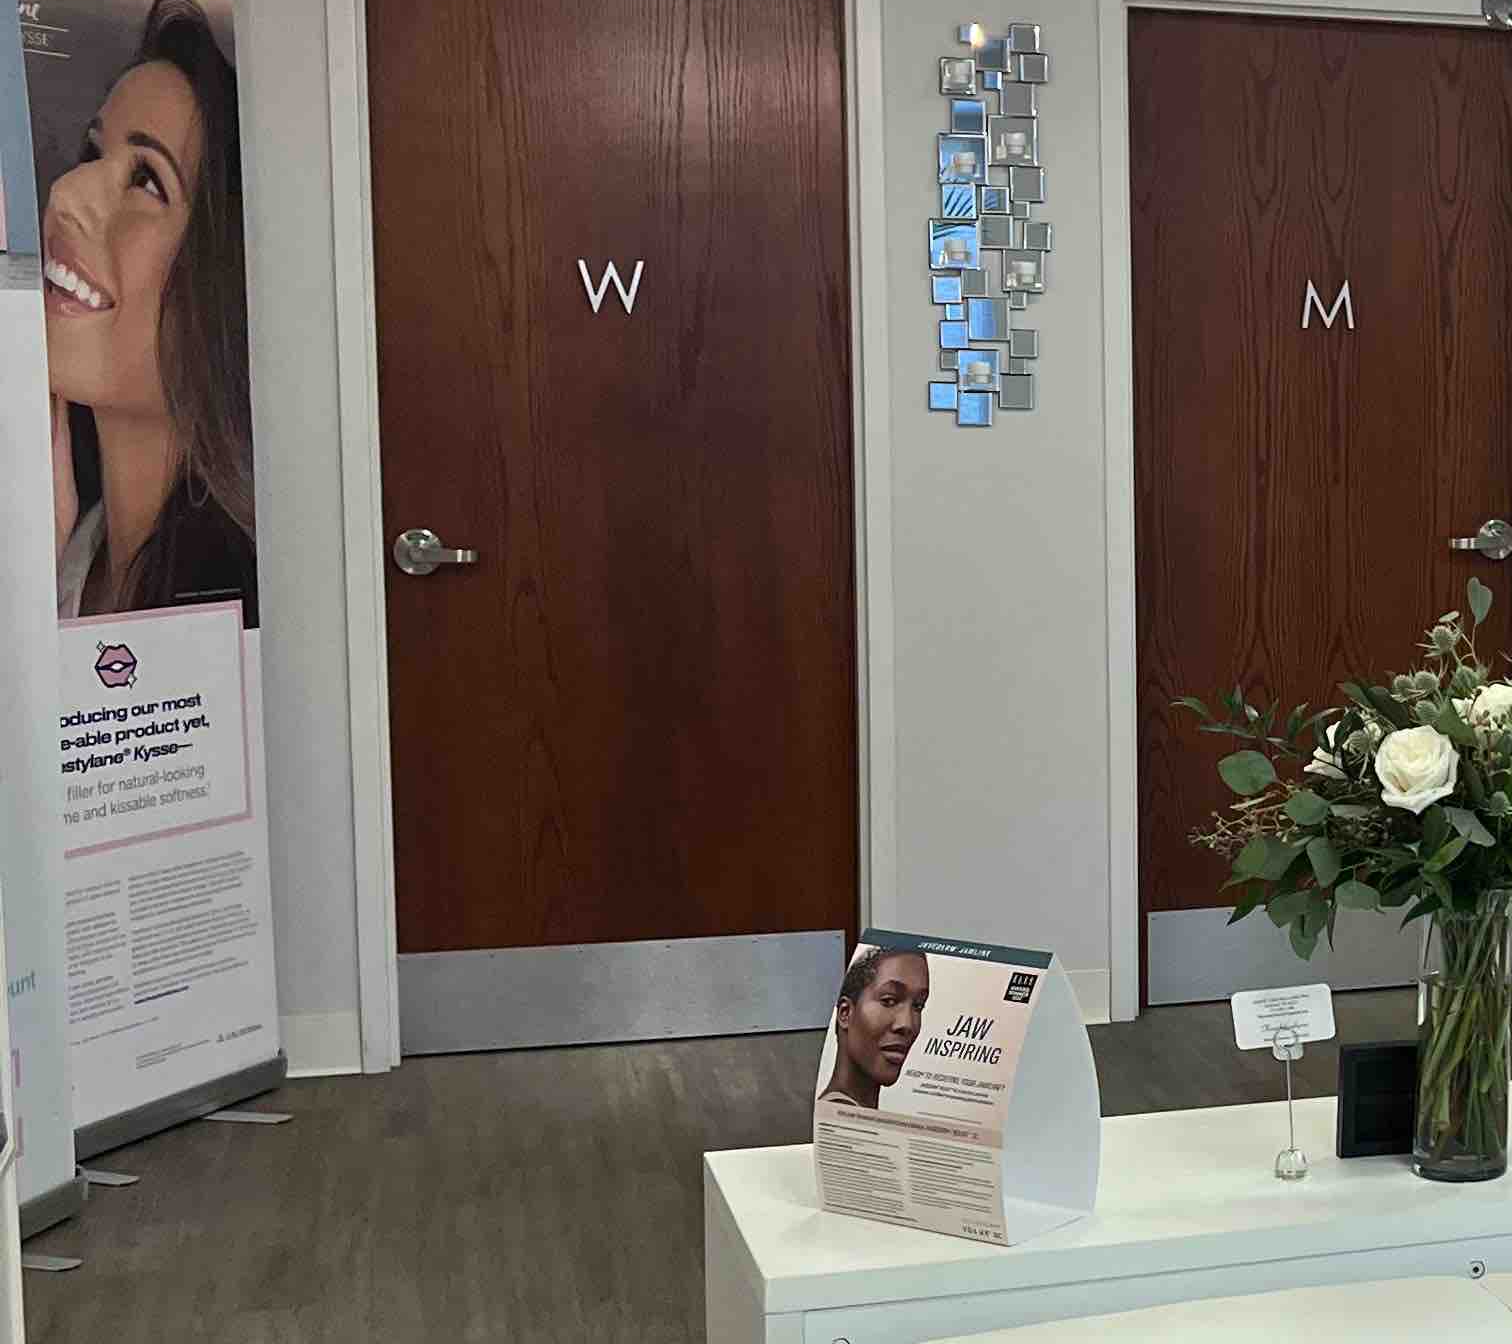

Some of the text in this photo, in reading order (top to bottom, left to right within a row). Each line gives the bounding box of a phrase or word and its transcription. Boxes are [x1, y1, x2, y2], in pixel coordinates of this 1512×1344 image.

[578, 259, 644, 314] W
[1302, 279, 1355, 329] M
[131, 702, 159, 717] our
[162, 693, 202, 712] most
[115, 719, 179, 745] product
[98, 781, 116, 795] for
[83, 803, 107, 822] and
[110, 794, 157, 817] kissable
[946, 1015, 994, 1041] JAW
[924, 1037, 1002, 1065] INSPIRING
